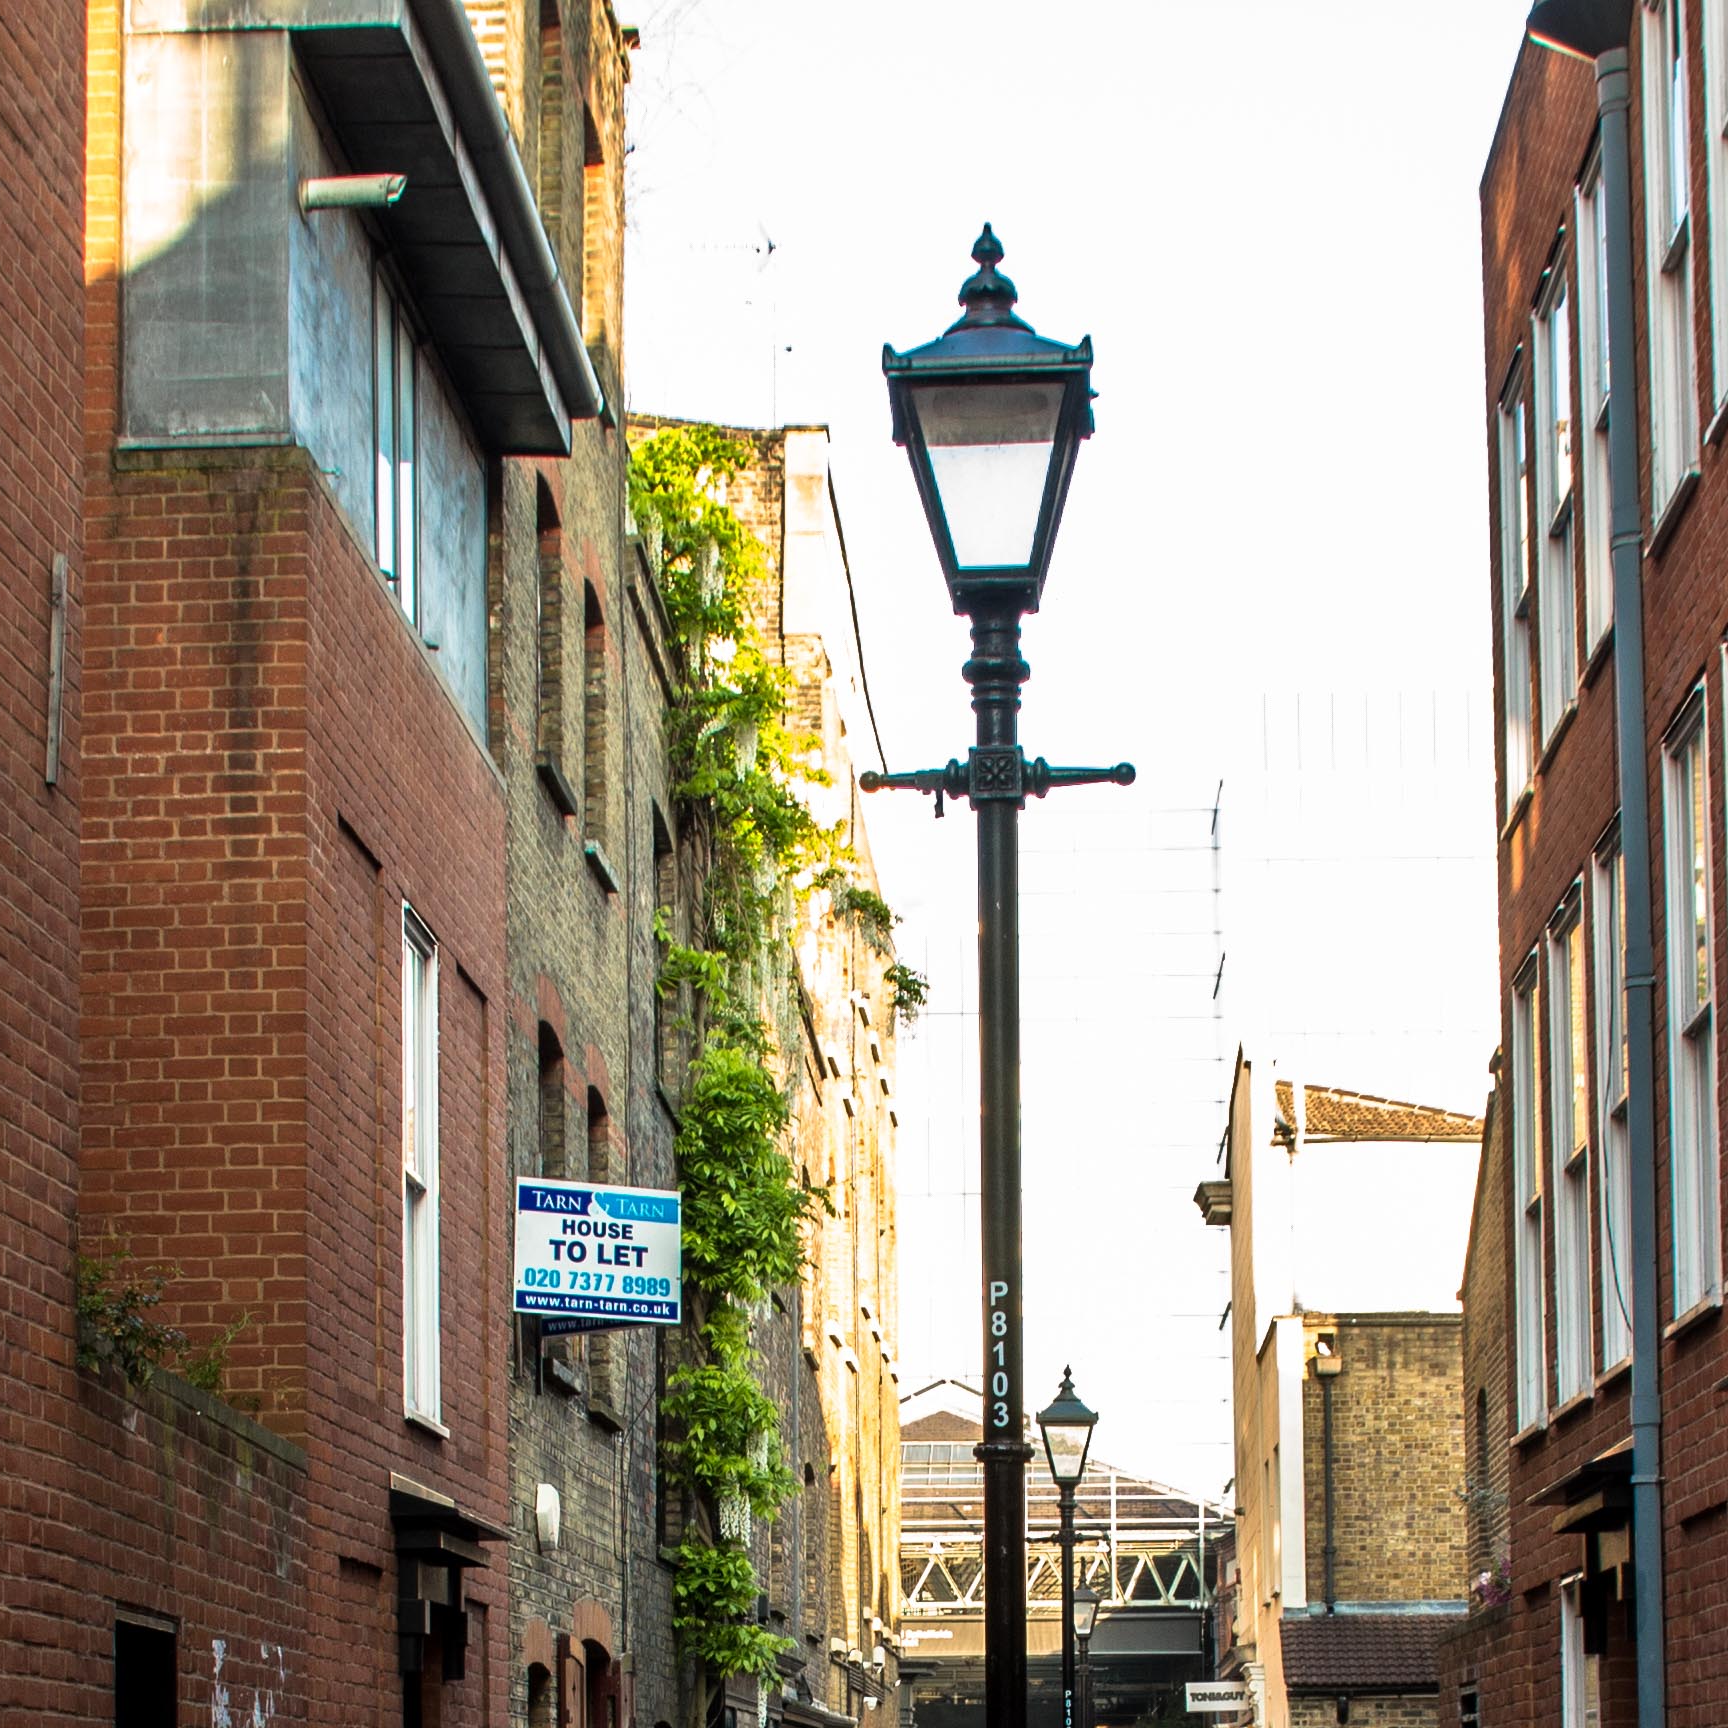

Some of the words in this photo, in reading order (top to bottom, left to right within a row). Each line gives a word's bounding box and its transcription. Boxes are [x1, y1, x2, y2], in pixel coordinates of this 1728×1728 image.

[531, 1190, 582, 1211] TARN
[616, 1198, 665, 1218] TARN
[562, 1218, 634, 1240] HOUSE
[549, 1238, 587, 1263] TO
[597, 1243, 649, 1268] LET
[524, 1267, 561, 1289] 020
[568, 1271, 615, 1293] 7377
[622, 1275, 671, 1297] 8989
[525, 1294, 671, 1316] www.tarn-tarn.co.uk
[990, 1280, 1010, 1428] P8103
